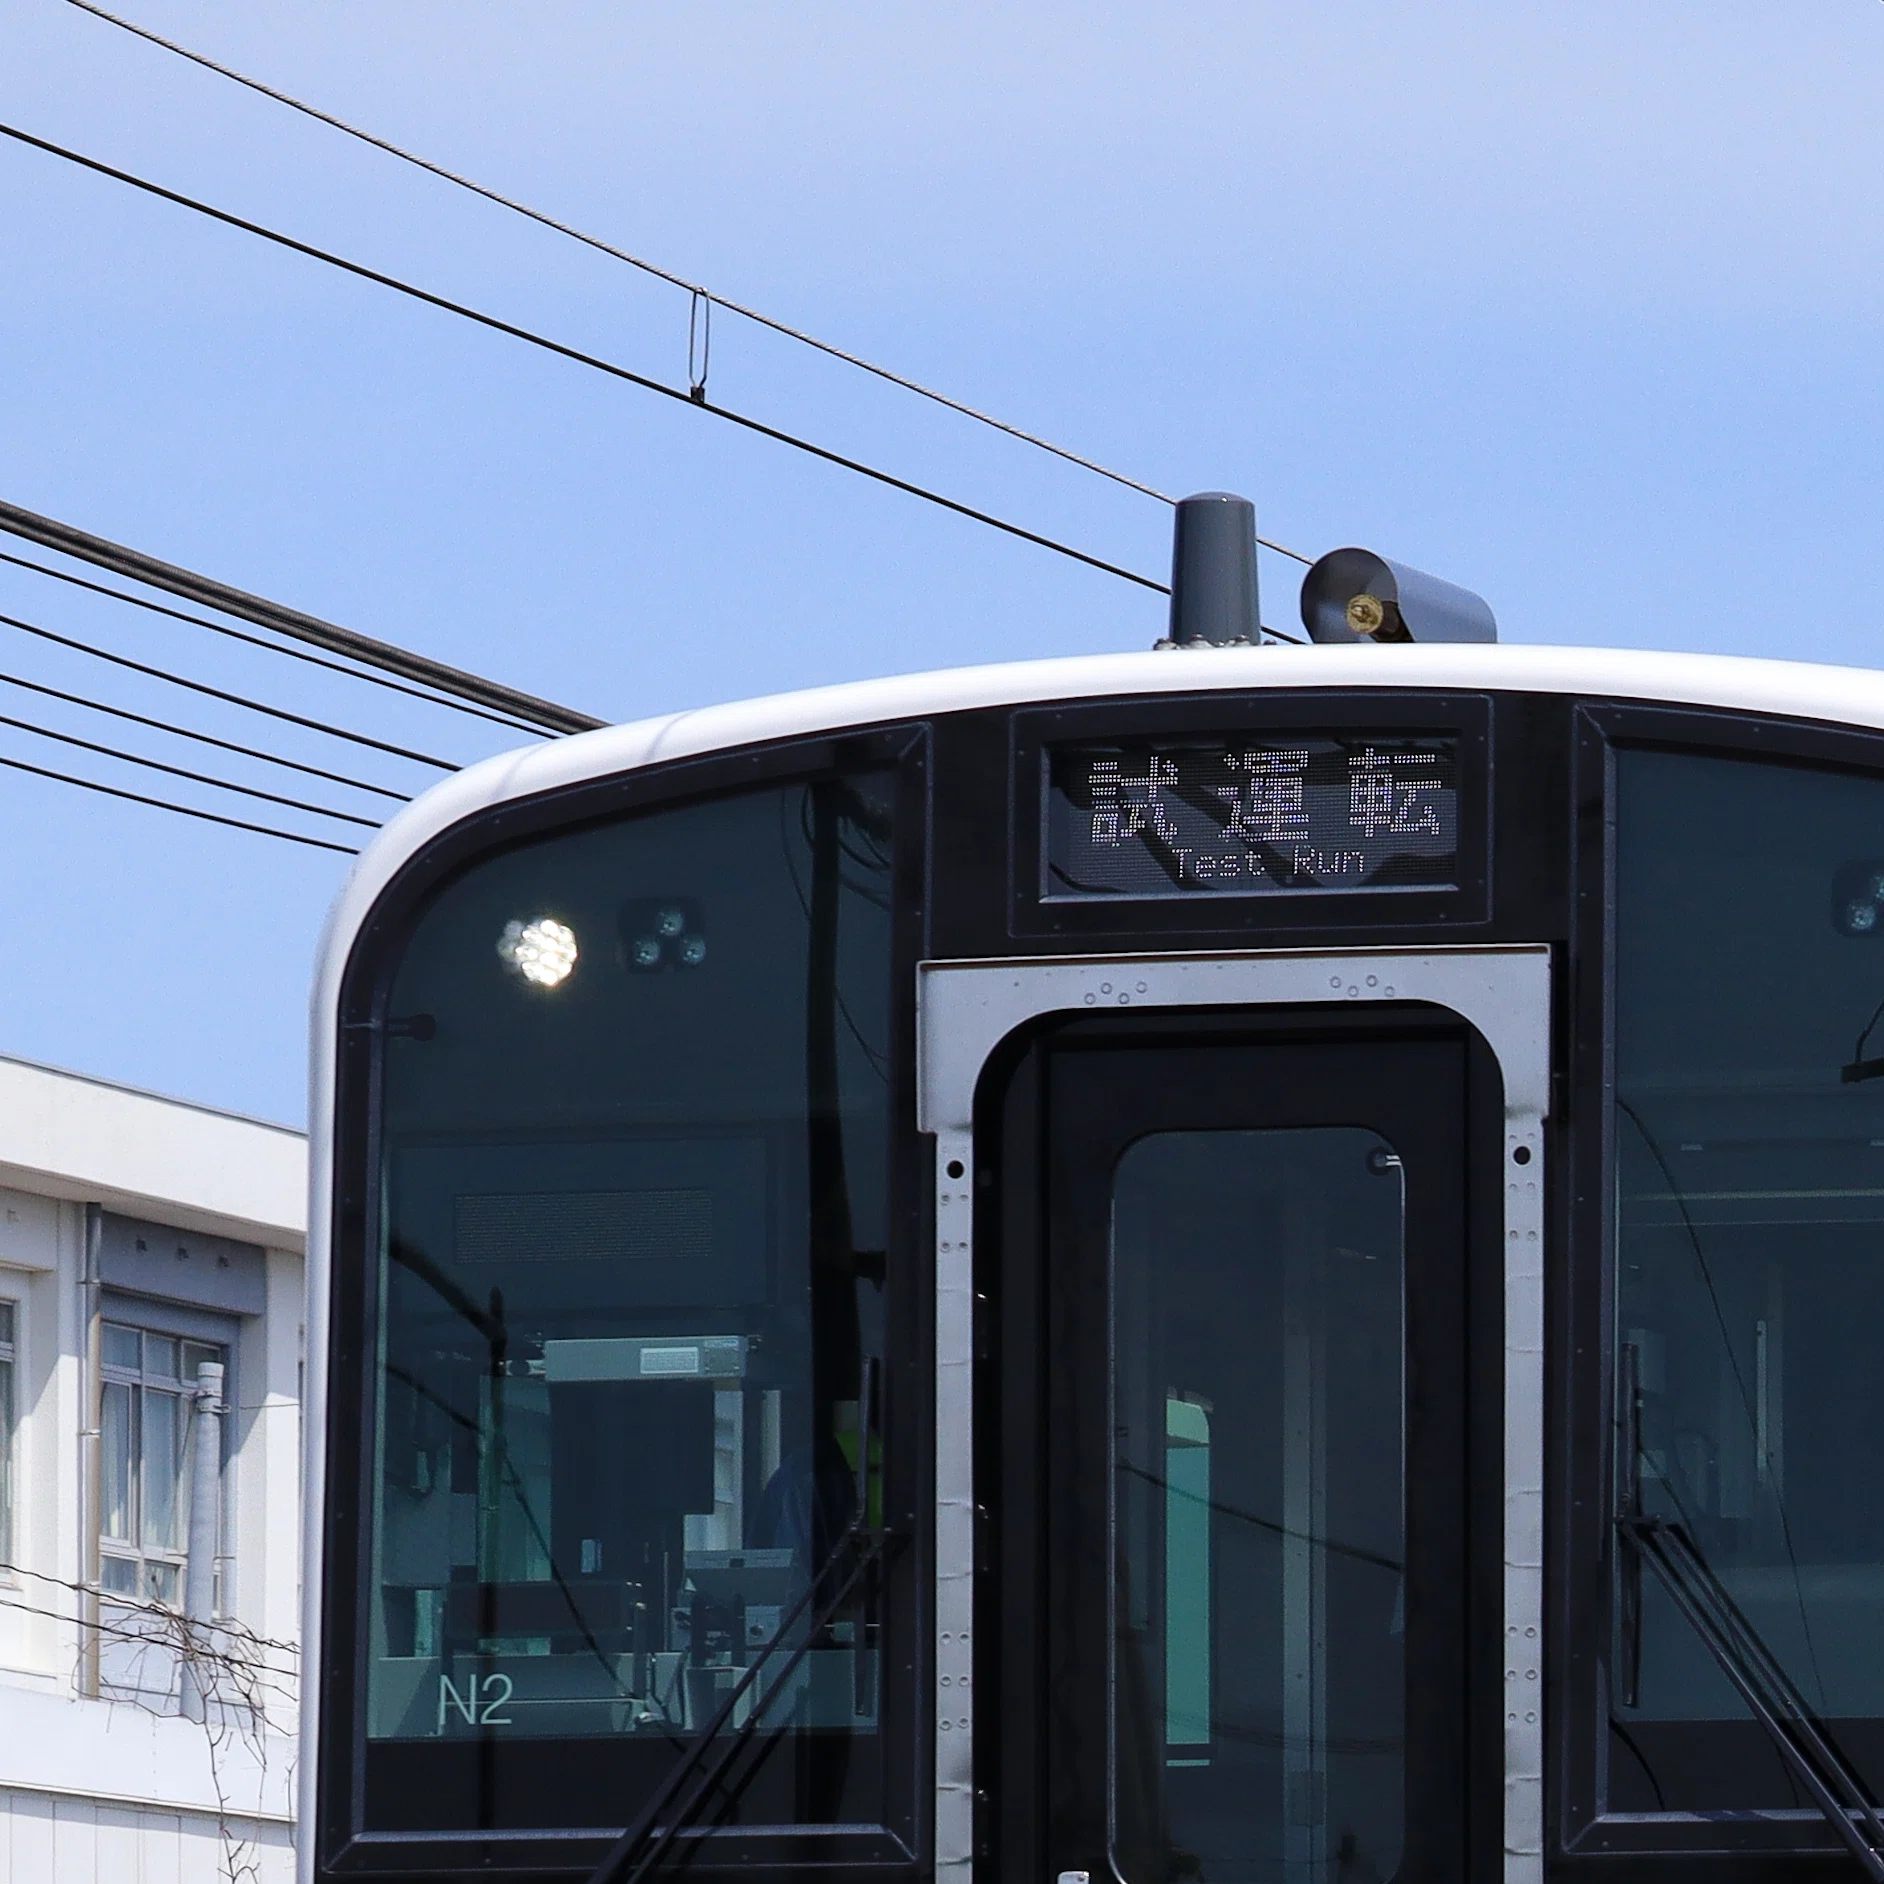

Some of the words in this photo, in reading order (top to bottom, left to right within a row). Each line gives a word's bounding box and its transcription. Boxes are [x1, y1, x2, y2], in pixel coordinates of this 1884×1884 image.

[1088, 747, 1442, 847] 試運転
[1171, 848, 1266, 879] Test
[1292, 844, 1366, 877] Run
[438, 1673, 513, 1726] N2
